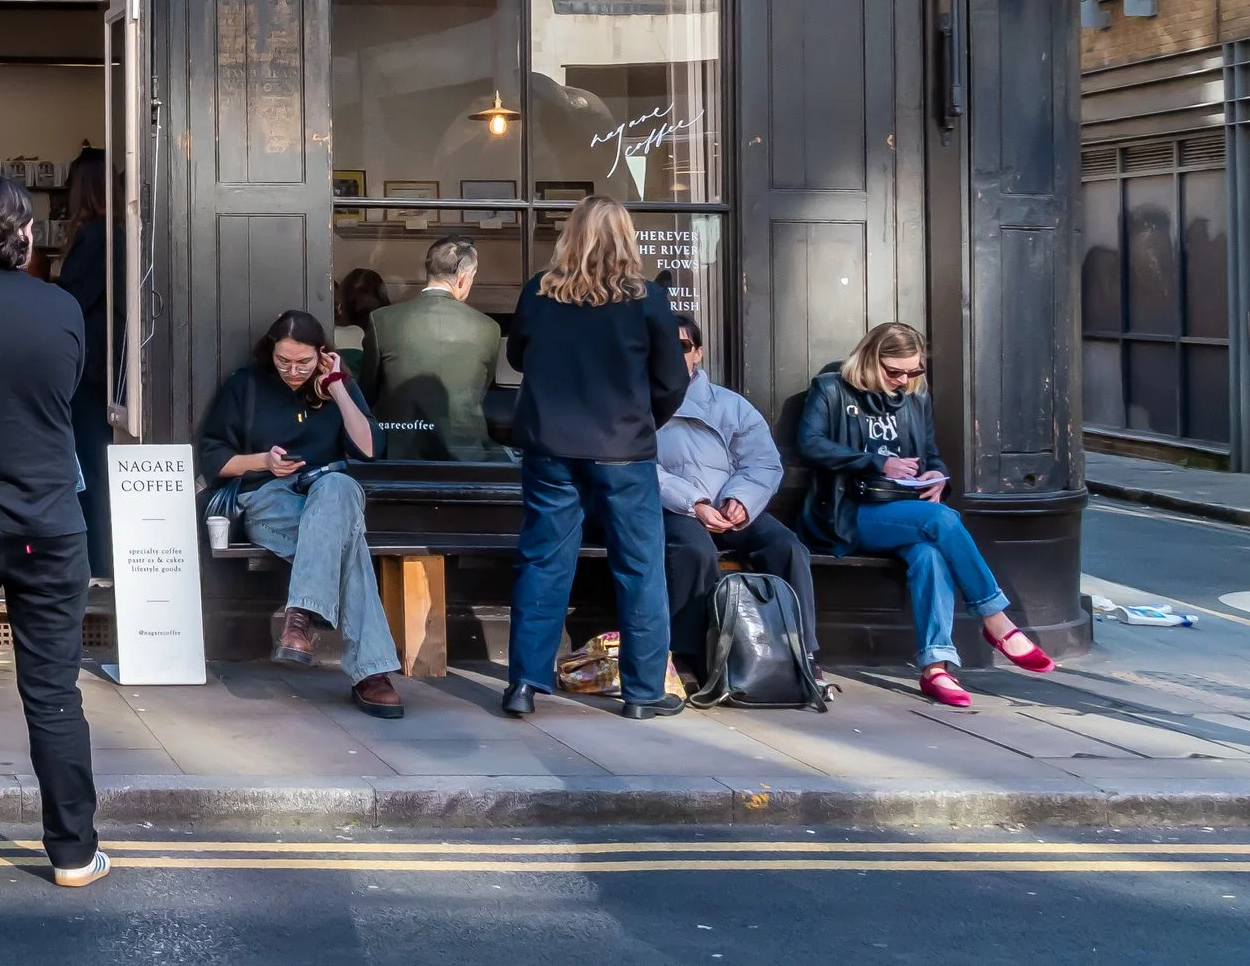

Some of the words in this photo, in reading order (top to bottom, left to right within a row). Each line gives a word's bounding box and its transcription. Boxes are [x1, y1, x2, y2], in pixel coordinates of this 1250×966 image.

[624, 109, 705, 157] coffee
[639, 244, 656, 255] HE
[661, 244, 699, 255] RIVER
[657, 258, 700, 269] FLOWS
[667, 287, 699, 298] WILL
[670, 301, 699, 311] RISH
[378, 419, 435, 431] garecoffee
[117, 460, 185, 472] NAGARE
[121, 480, 184, 492] COFFEE
[129, 547, 159, 555] specialty
[161, 547, 182, 555] coffee
[131, 565, 159, 573] lifestyle
[161, 565, 182, 573] goods
